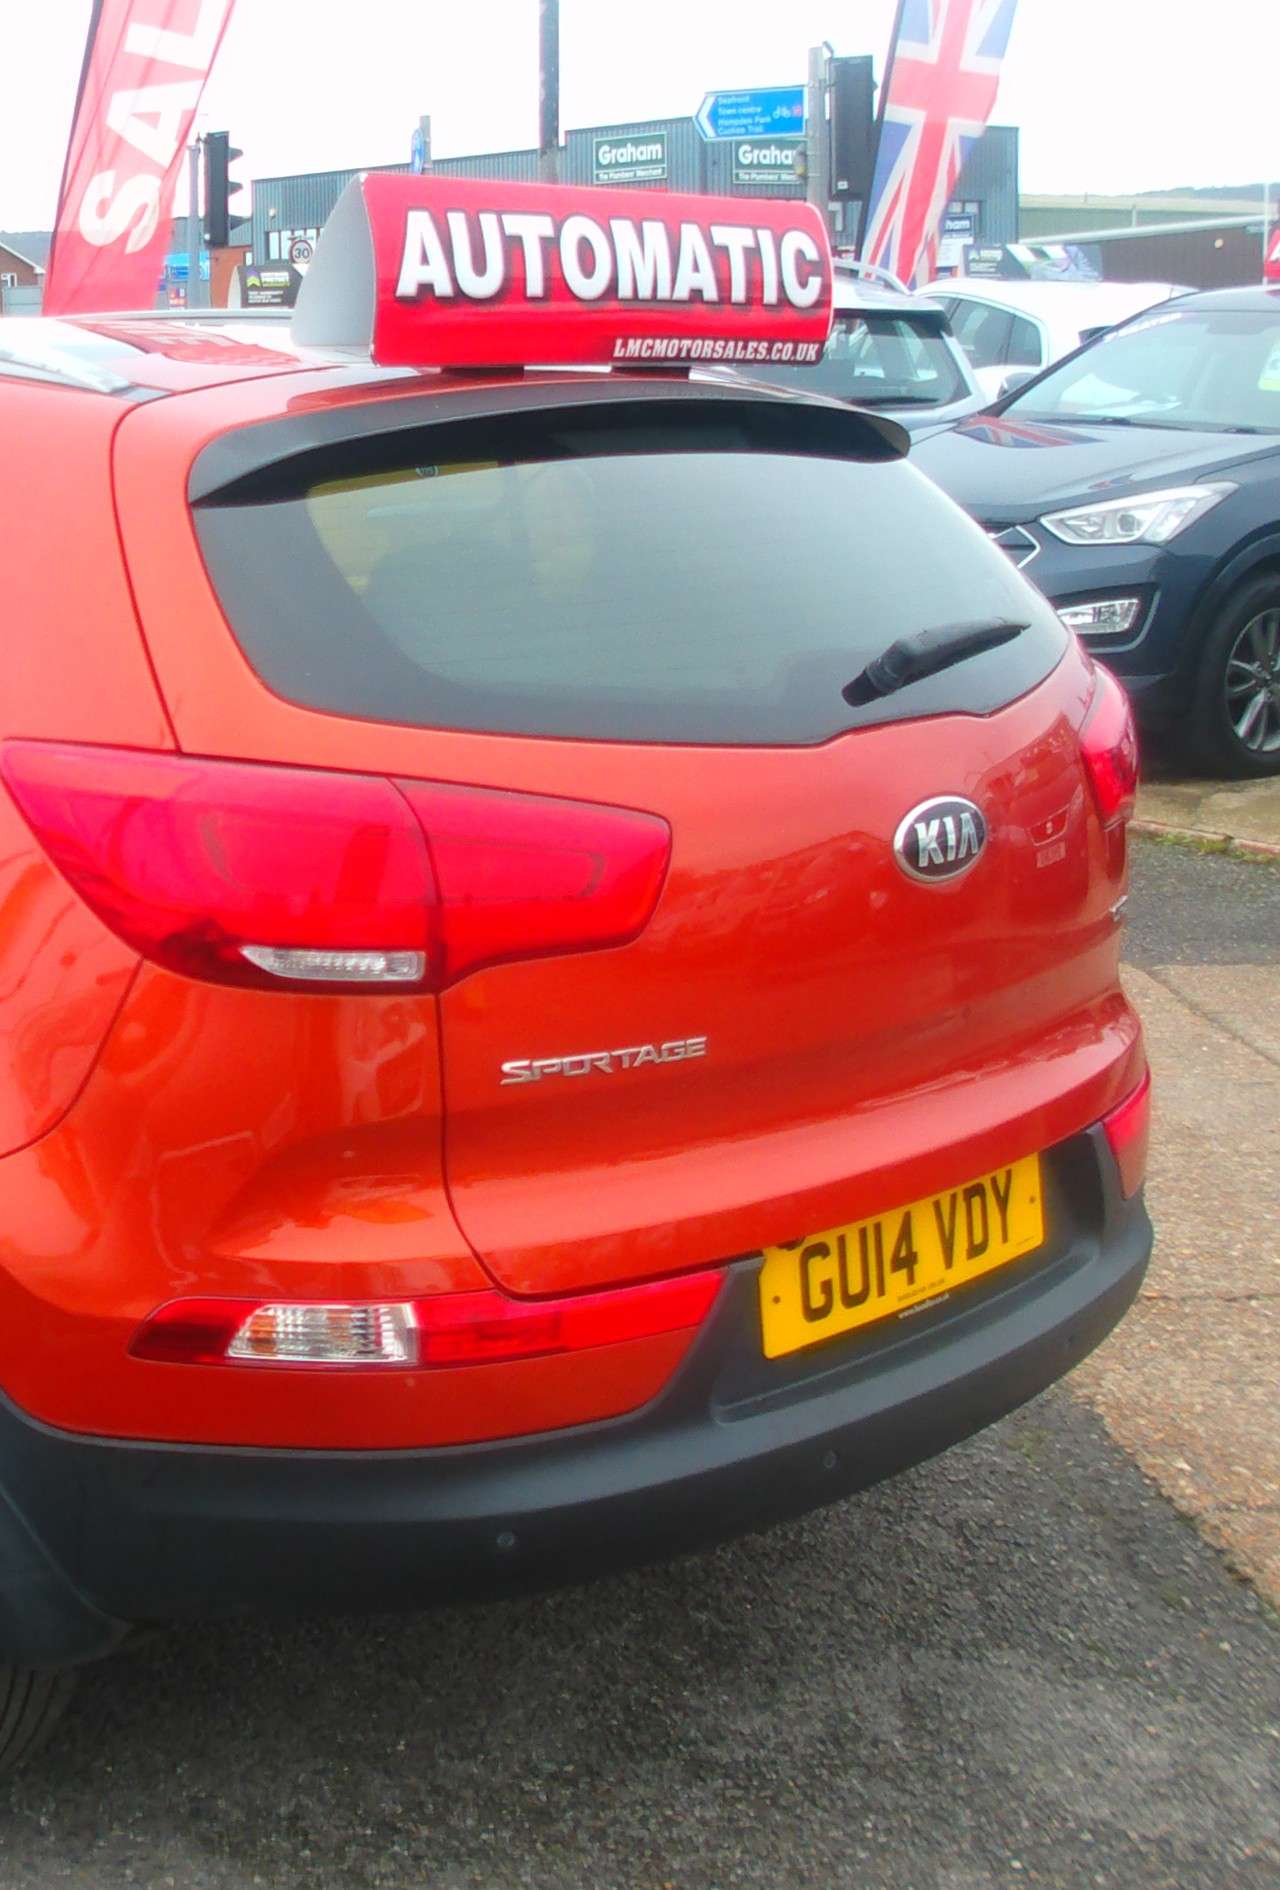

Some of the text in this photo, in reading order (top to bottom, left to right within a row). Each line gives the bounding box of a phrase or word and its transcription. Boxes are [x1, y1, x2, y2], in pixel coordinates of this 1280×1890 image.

[77, 0, 233, 254] SAL
[598, 142, 662, 165] Graham
[944, 218, 971, 230] ham
[295, 248, 310, 259] 30
[396, 210, 822, 308] AUTOMATIC
[613, 338, 819, 362] LMCMOTORSALES.CO.UK
[914, 812, 979, 868] KIA
[500, 1036, 707, 1085] SPORTAGE
[799, 1169, 1013, 1323] GU14 VDY
